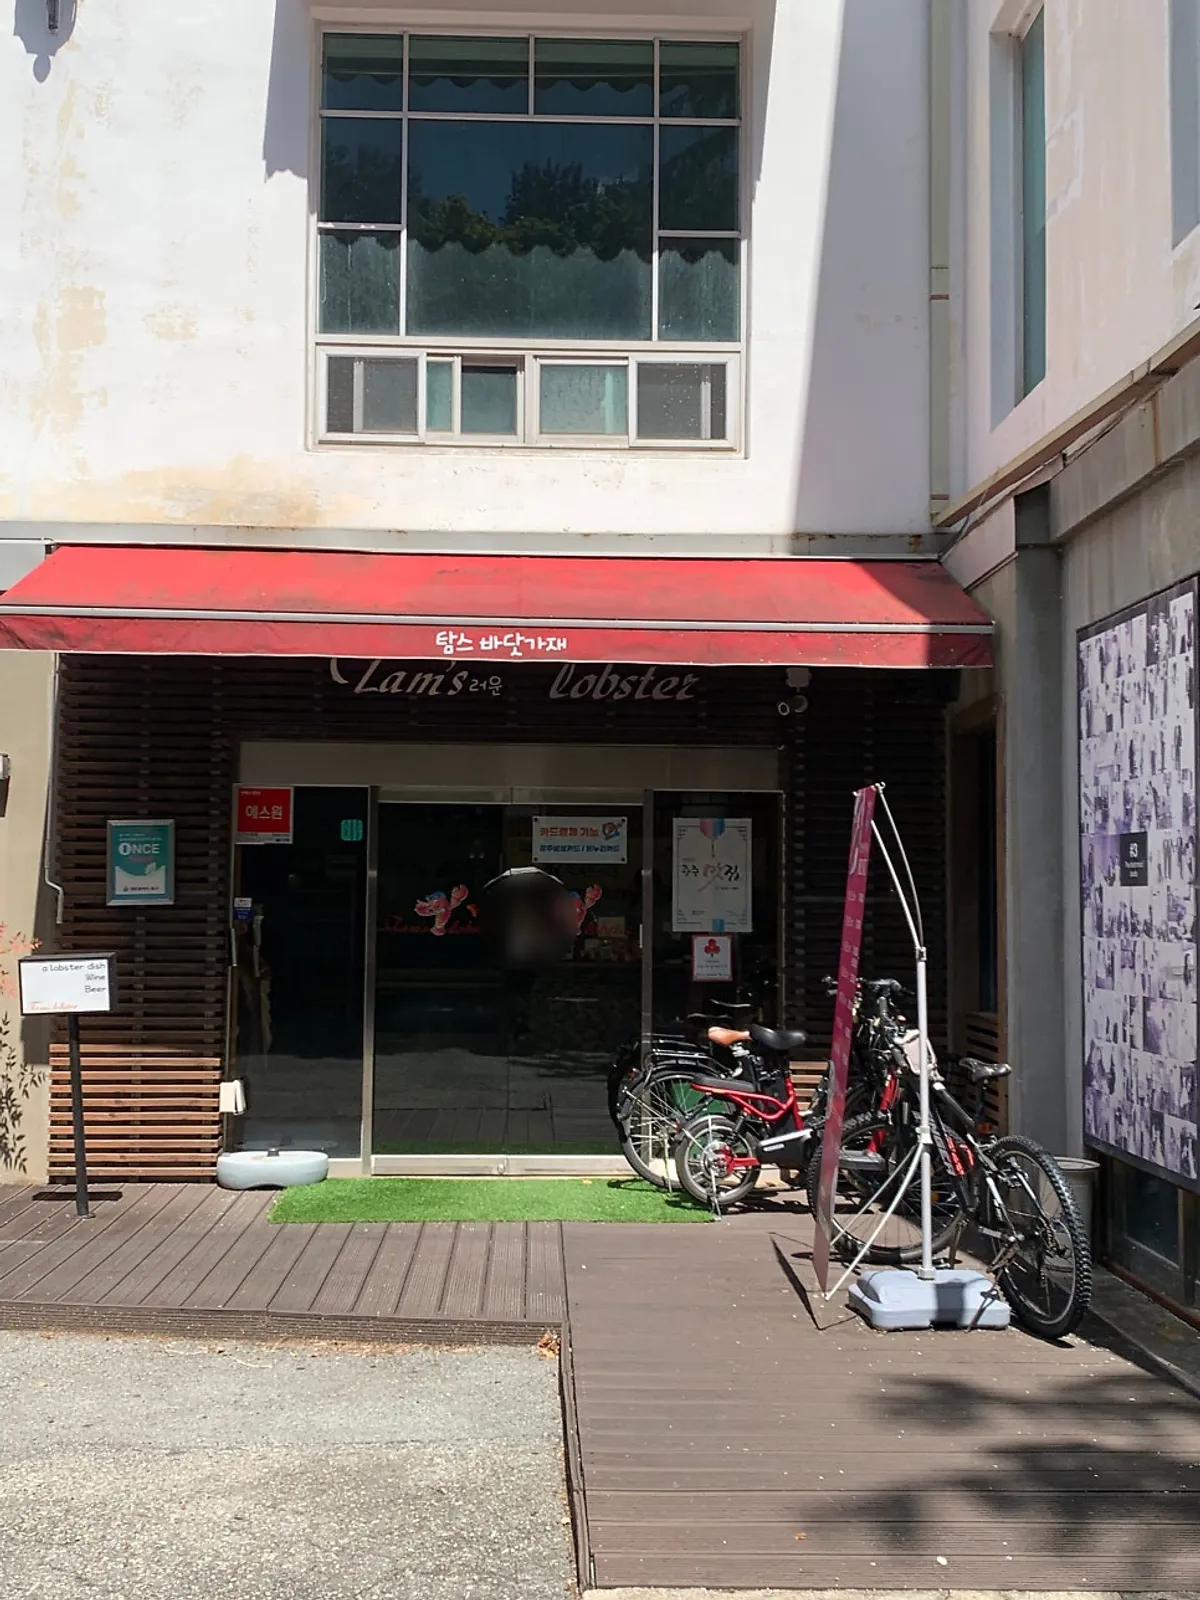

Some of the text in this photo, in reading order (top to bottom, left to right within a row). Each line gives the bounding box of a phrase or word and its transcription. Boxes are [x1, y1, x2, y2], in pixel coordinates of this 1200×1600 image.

[435, 631, 568, 656] 탐스 바닷가재
[550, 664, 701, 700] lobster
[245, 805, 284, 820] 에스원
[49, 964, 84, 973] lobster
[87, 961, 106, 970] dish
[85, 973, 106, 982] Wine
[84, 985, 106, 993] Beer
